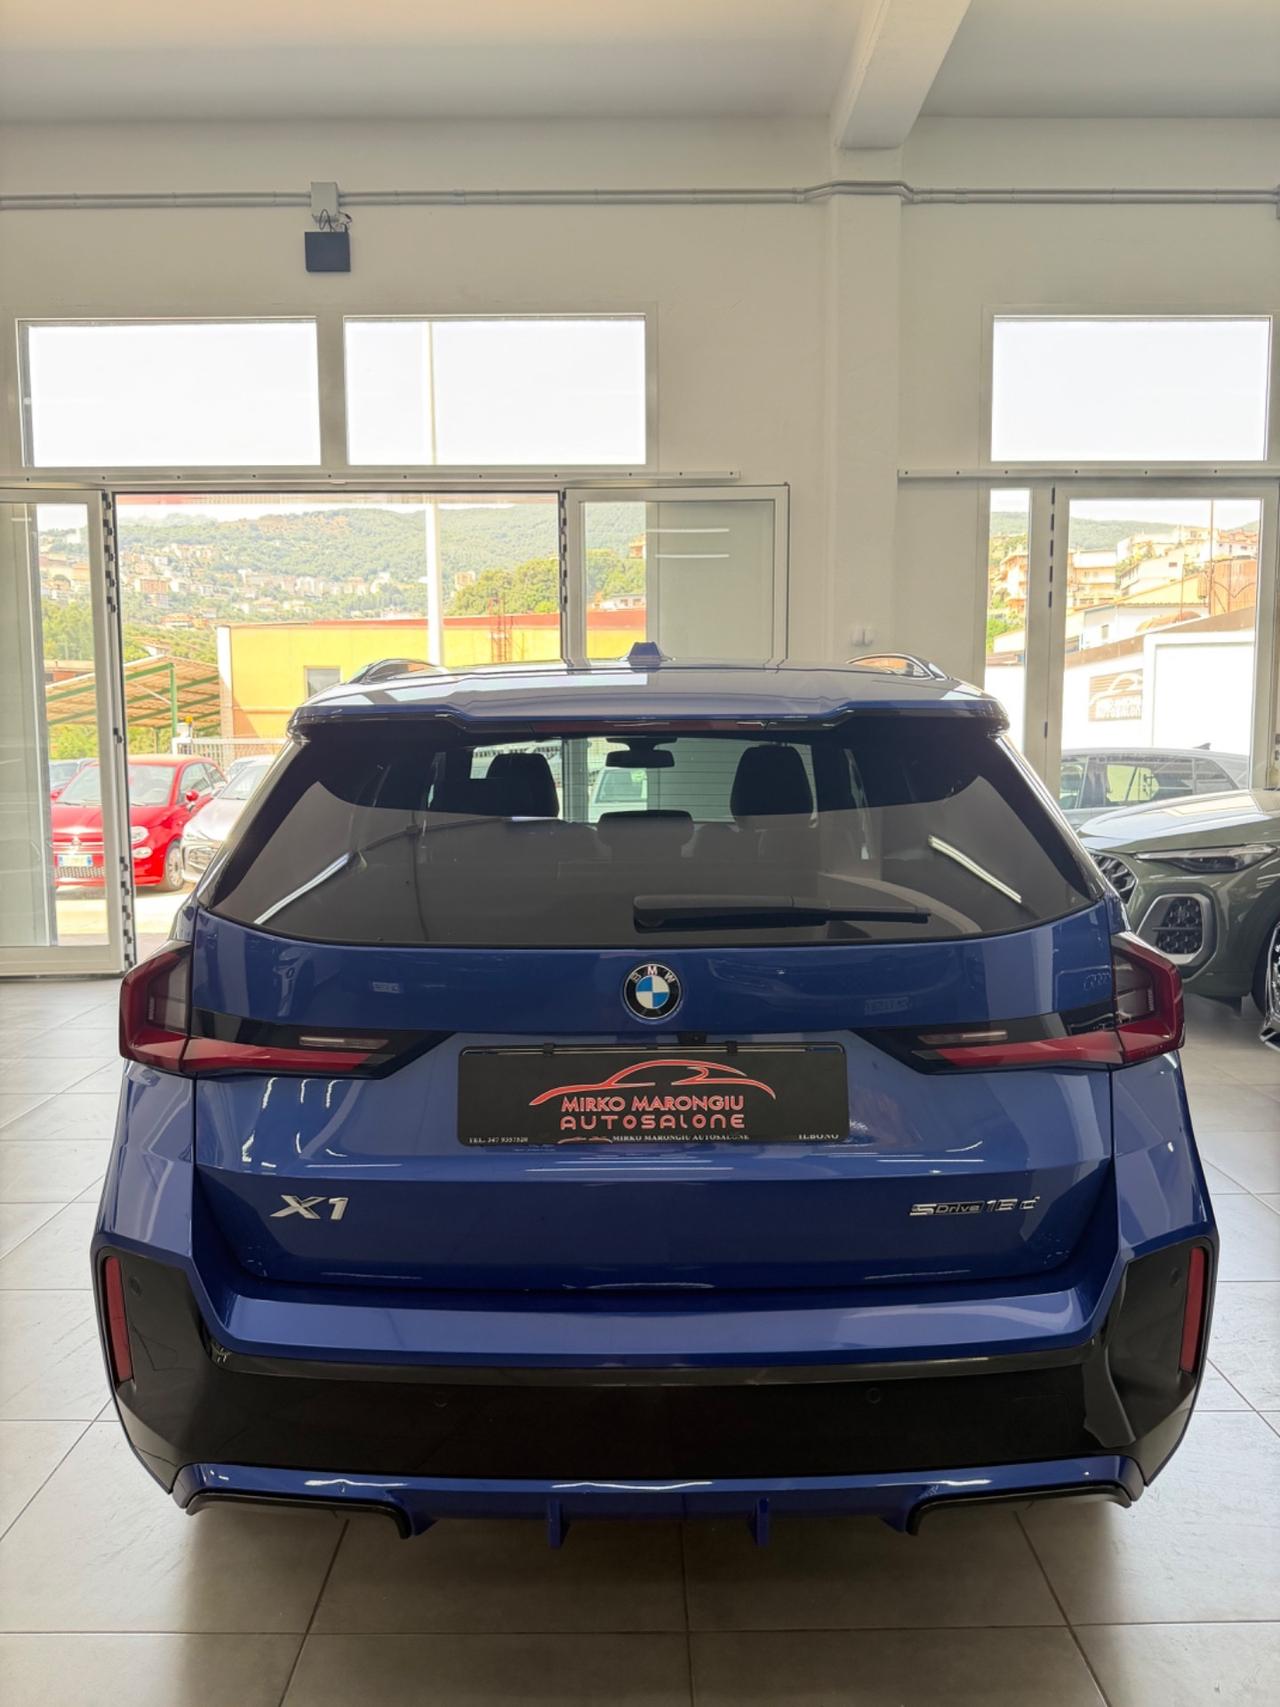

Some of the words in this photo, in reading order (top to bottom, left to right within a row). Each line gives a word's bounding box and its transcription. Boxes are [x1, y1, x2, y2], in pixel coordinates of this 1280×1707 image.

[630, 965, 676, 983] BMW
[561, 1095, 625, 1112] MIRKO
[631, 1095, 744, 1111] MARONGIU
[560, 1114, 745, 1130] AUTOSALONE
[269, 1194, 349, 1220] X1
